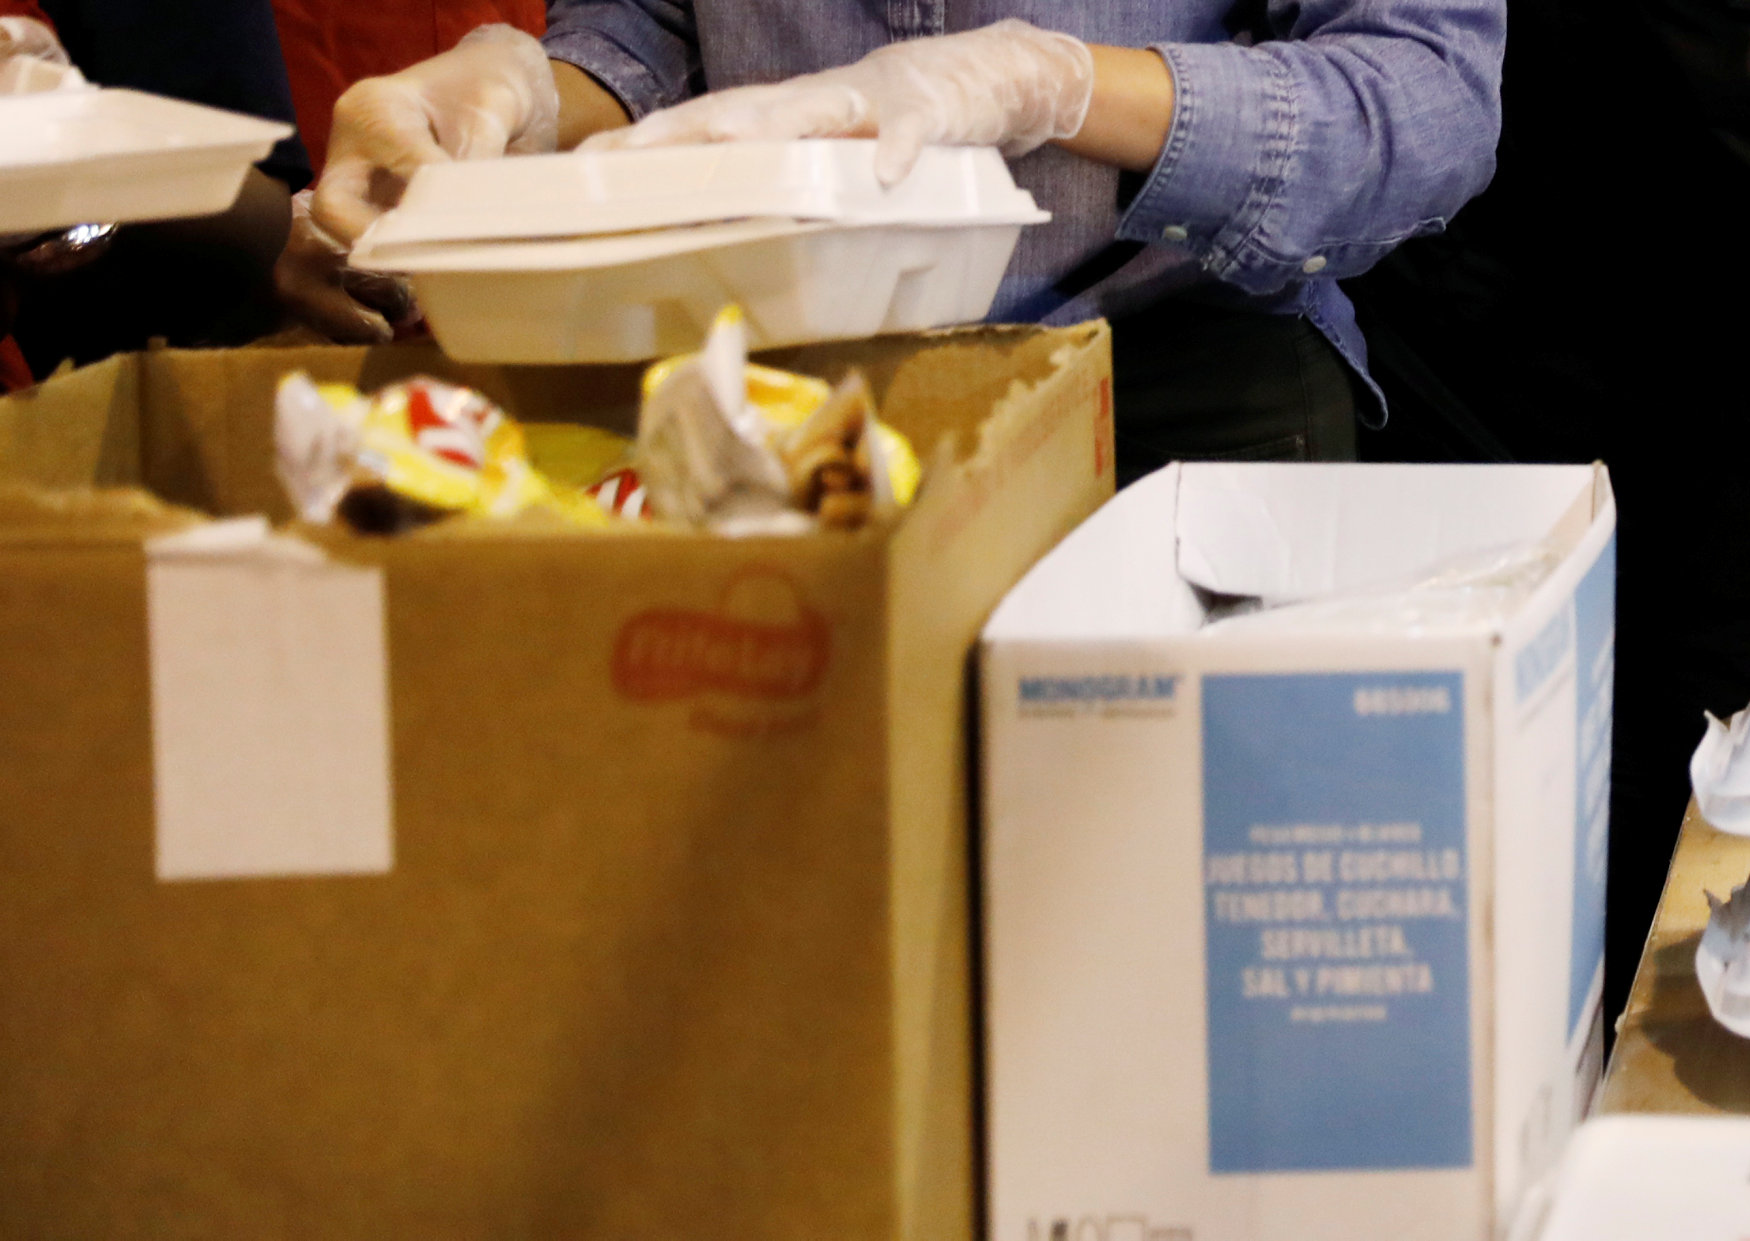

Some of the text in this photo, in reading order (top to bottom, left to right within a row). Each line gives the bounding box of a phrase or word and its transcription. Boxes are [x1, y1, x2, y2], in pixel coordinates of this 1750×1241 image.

[1019, 674, 1176, 702] MONOGRAM
[1207, 853, 1297, 884] JUEGOS
[1303, 852, 1334, 883] DE
[1242, 963, 1433, 998] SAL Y PIMIENTA
